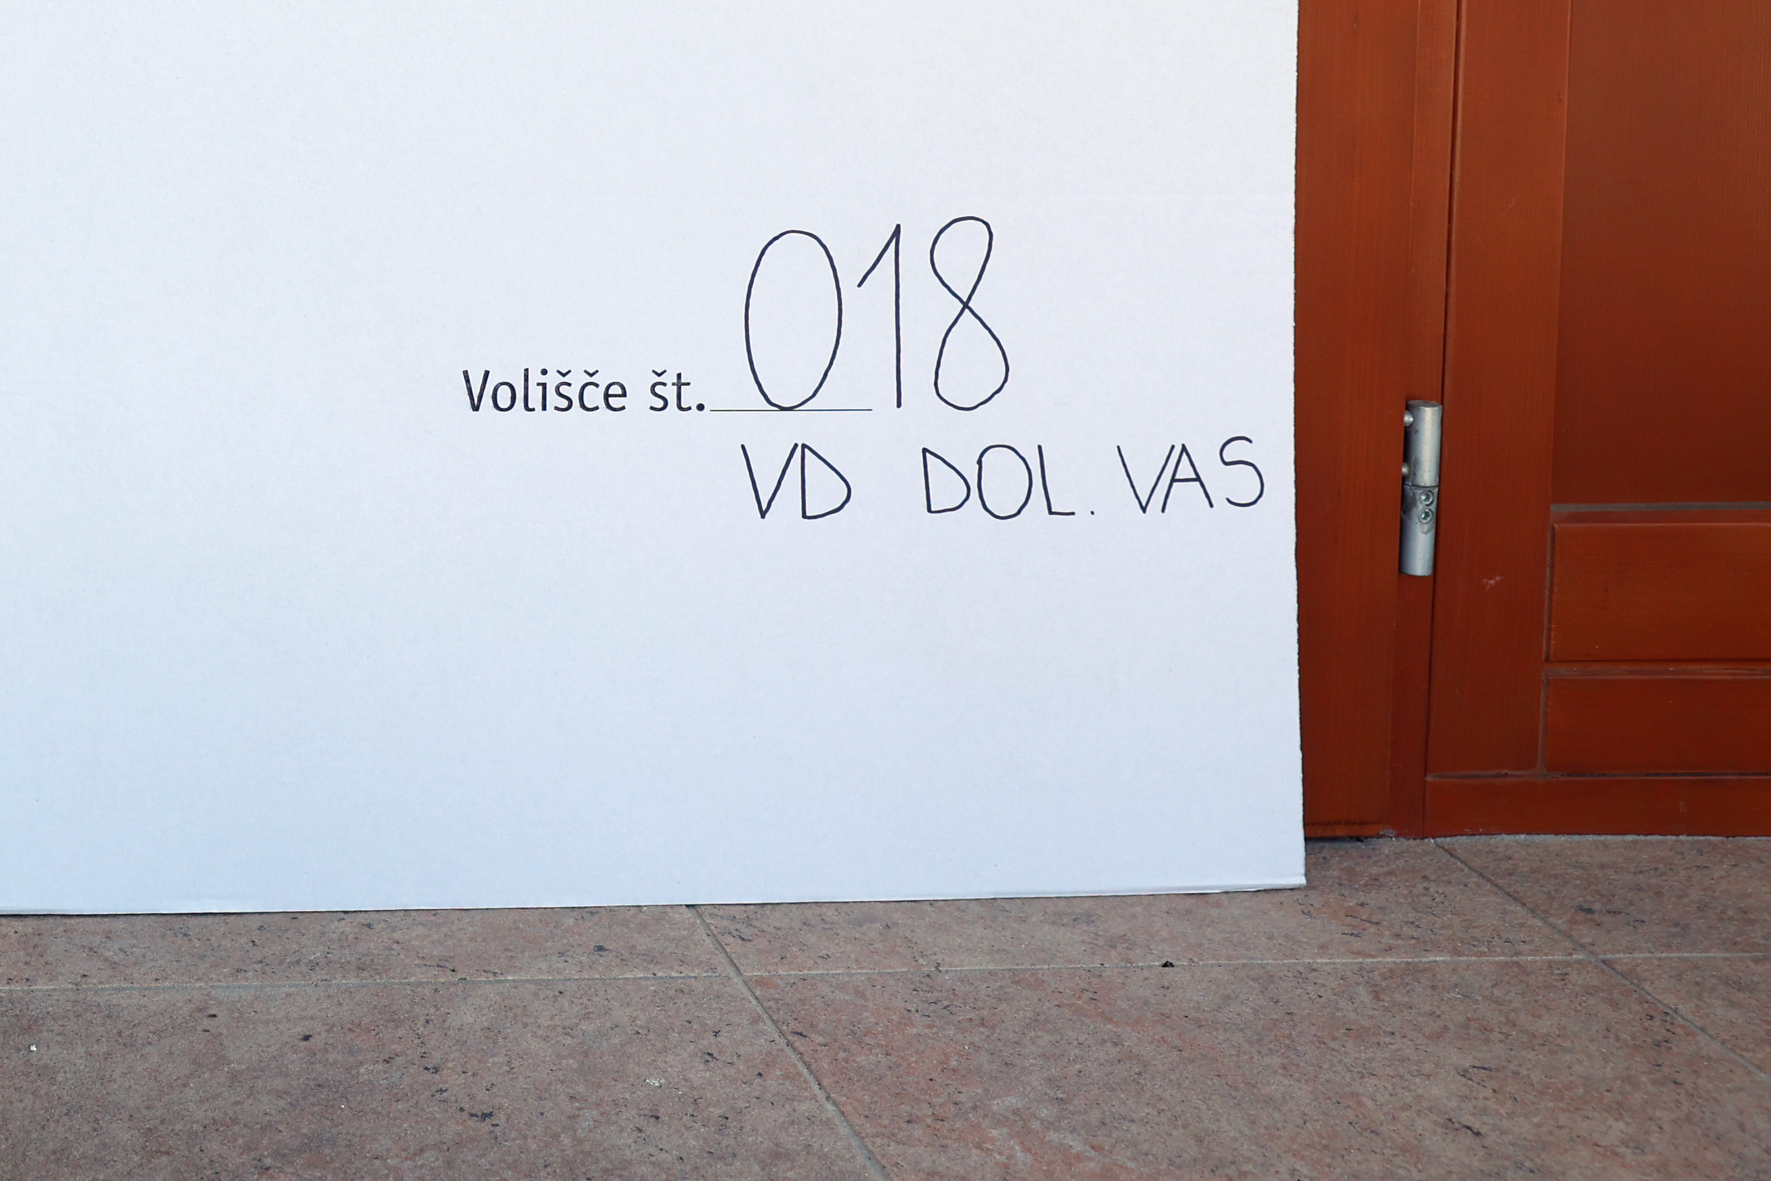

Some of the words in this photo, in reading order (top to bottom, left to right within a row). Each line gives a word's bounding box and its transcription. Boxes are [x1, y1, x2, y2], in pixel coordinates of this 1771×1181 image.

[743, 215, 1011, 412] 018
[462, 367, 628, 413] Volišče
[649, 369, 707, 413] št.
[740, 442, 853, 521] VD
[921, 443, 1097, 521] DOL.
[1116, 435, 1266, 516] VAS
